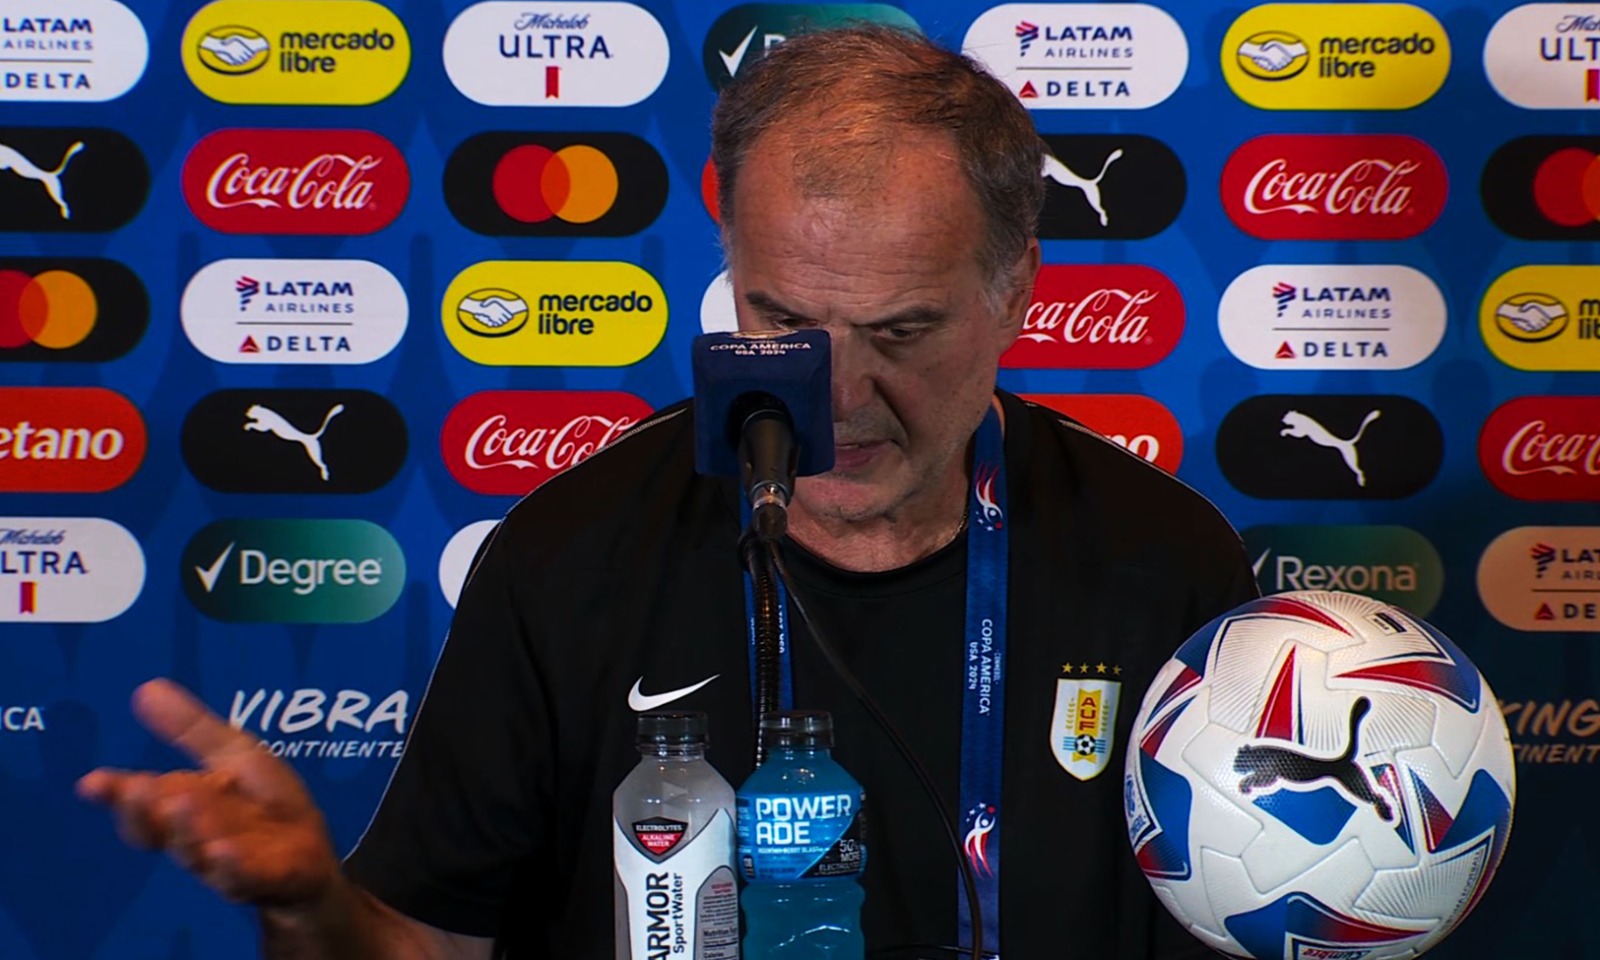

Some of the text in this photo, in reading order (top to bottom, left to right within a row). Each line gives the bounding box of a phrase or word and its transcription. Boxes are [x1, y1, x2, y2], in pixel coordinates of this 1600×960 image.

[3, 18, 92, 33] LATAM
[514, 12, 591, 31] Michelob
[279, 29, 395, 50] mercado
[1045, 26, 1133, 41] LATAM
[1319, 33, 1435, 55] mercado
[3, 39, 94, 51] AIRLINES
[499, 35, 610, 58] ULTRA
[1045, 48, 1133, 58] AIRLINES
[279, 52, 336, 73] libre
[1319, 57, 1375, 78] libre
[5, 73, 91, 89] DELTA
[1046, 81, 1130, 97] DELTA
[206, 152, 382, 209] Coca-Cola
[1243, 158, 1421, 215] Coca-Cola
[265, 281, 354, 297] LATAM
[1302, 287, 1391, 302] LATAM
[265, 302, 355, 313] AIRLINES
[538, 290, 652, 313] mercado
[1302, 308, 1391, 319] AIRLINES
[538, 314, 594, 336] libre
[267, 336, 352, 352] DELTA
[750, 342, 812, 350] AMERICA
[1303, 341, 1389, 358] DELTA
[240, 550, 382, 595] Degree
[1276, 556, 1417, 591] Rexona
[967, 641, 979, 690] USA 2024
[979, 618, 993, 714] COPA AMERICA
[229, 688, 409, 734] VIBRA
[1079, 696, 1096, 731] AUF
[756, 794, 852, 821] POWER
[635, 824, 683, 832] ELECTROLYTES
[641, 832, 676, 841] ALKALINE
[756, 821, 812, 846] ADE
[671, 872, 687, 954] SportWater
